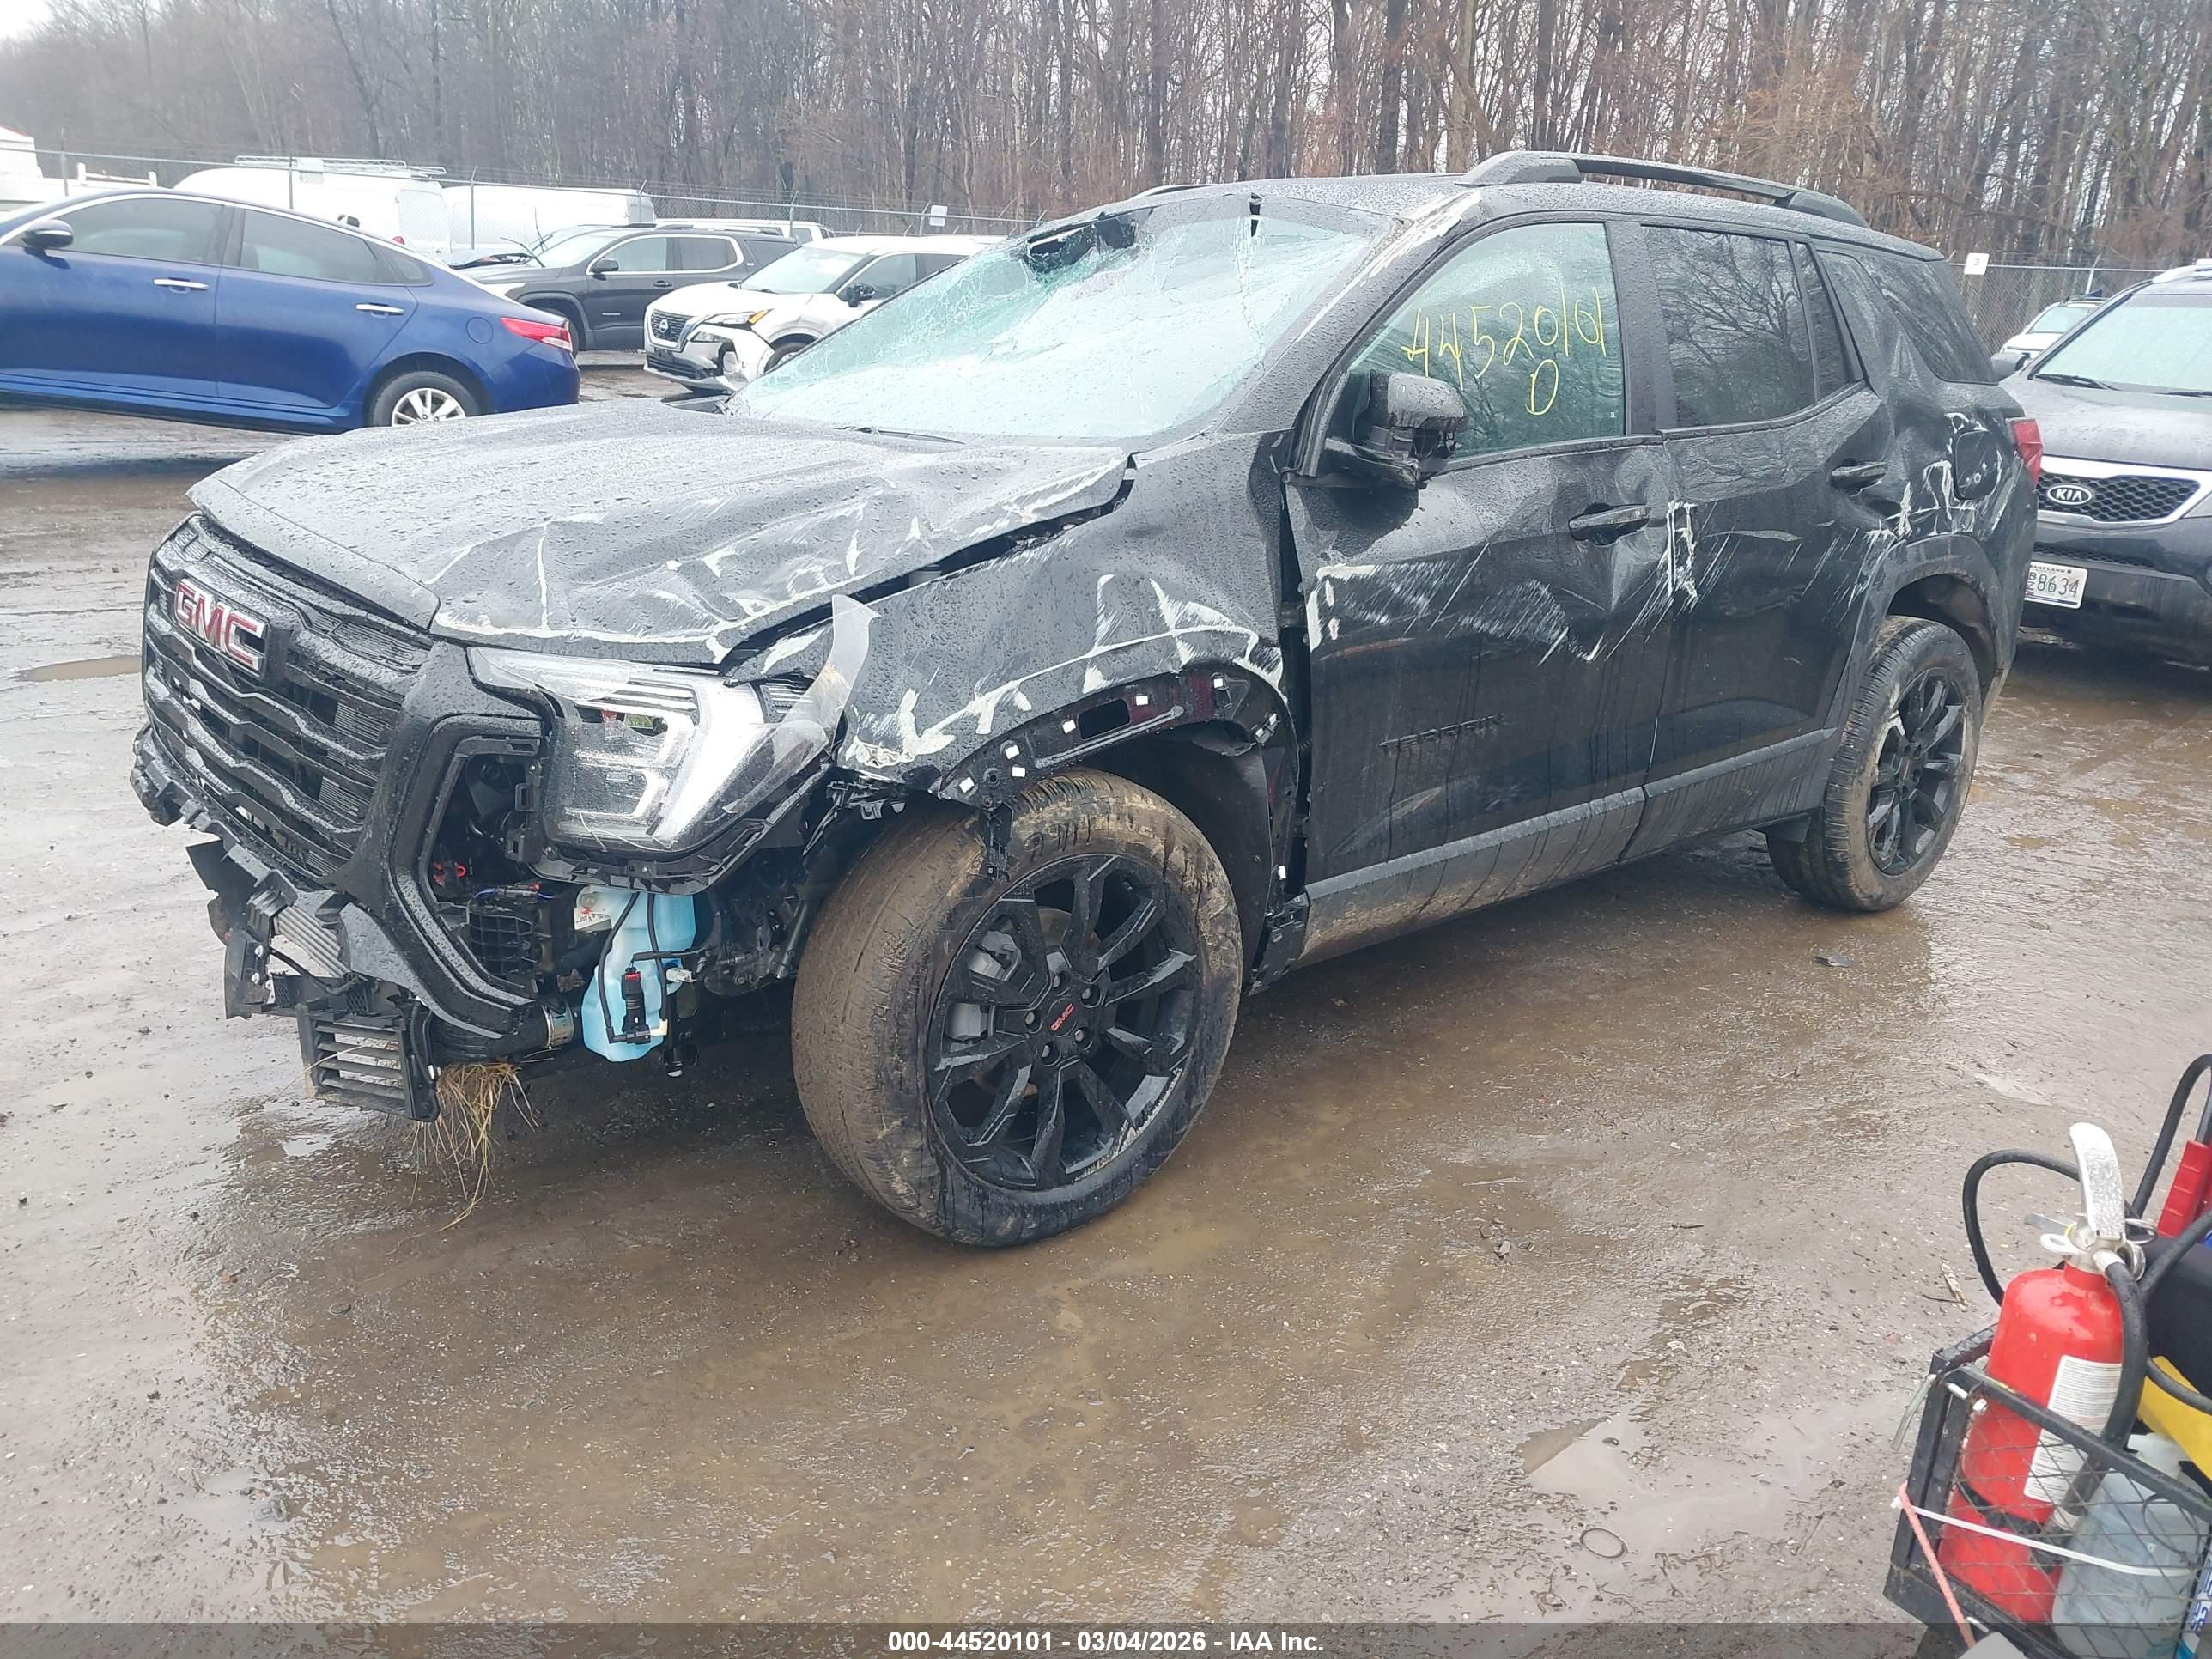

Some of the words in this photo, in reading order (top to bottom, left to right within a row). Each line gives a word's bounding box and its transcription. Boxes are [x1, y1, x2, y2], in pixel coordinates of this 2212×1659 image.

[1401, 287, 1607, 392] 44520101
[2056, 489, 2083, 501] KIA
[2037, 574, 2080, 598] 8634
[174, 578, 267, 676] GMC
[1050, 1002, 1074, 1031] GMC
